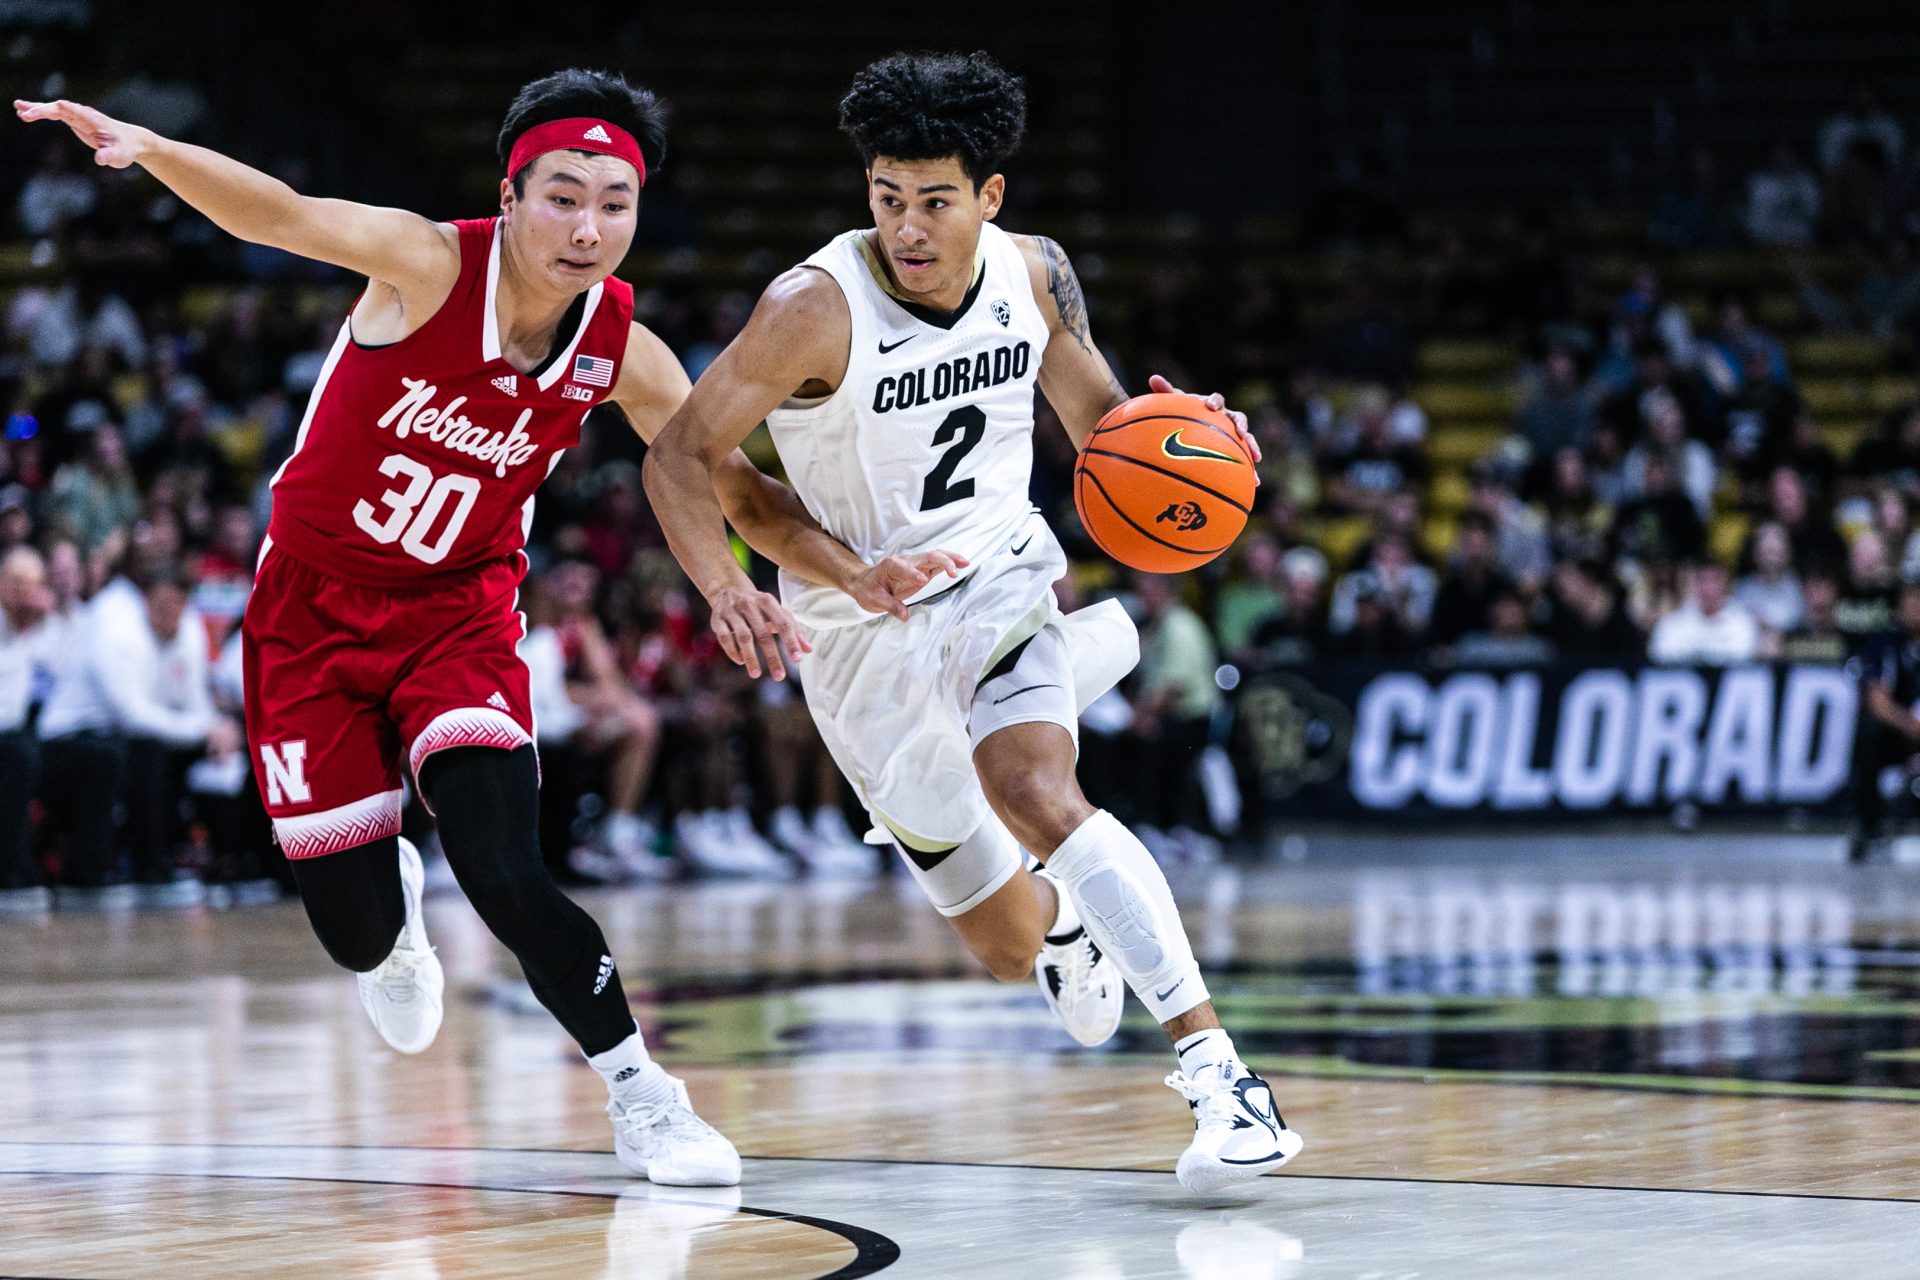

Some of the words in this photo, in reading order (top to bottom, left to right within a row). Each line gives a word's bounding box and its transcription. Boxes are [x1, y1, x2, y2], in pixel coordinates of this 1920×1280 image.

[490, 378, 519, 398] adidas
[872, 340, 1030, 414] COLORADO
[377, 376, 539, 478] Nebraska
[919, 404, 986, 512] 2
[352, 453, 481, 565] 30
[260, 739, 312, 806] N
